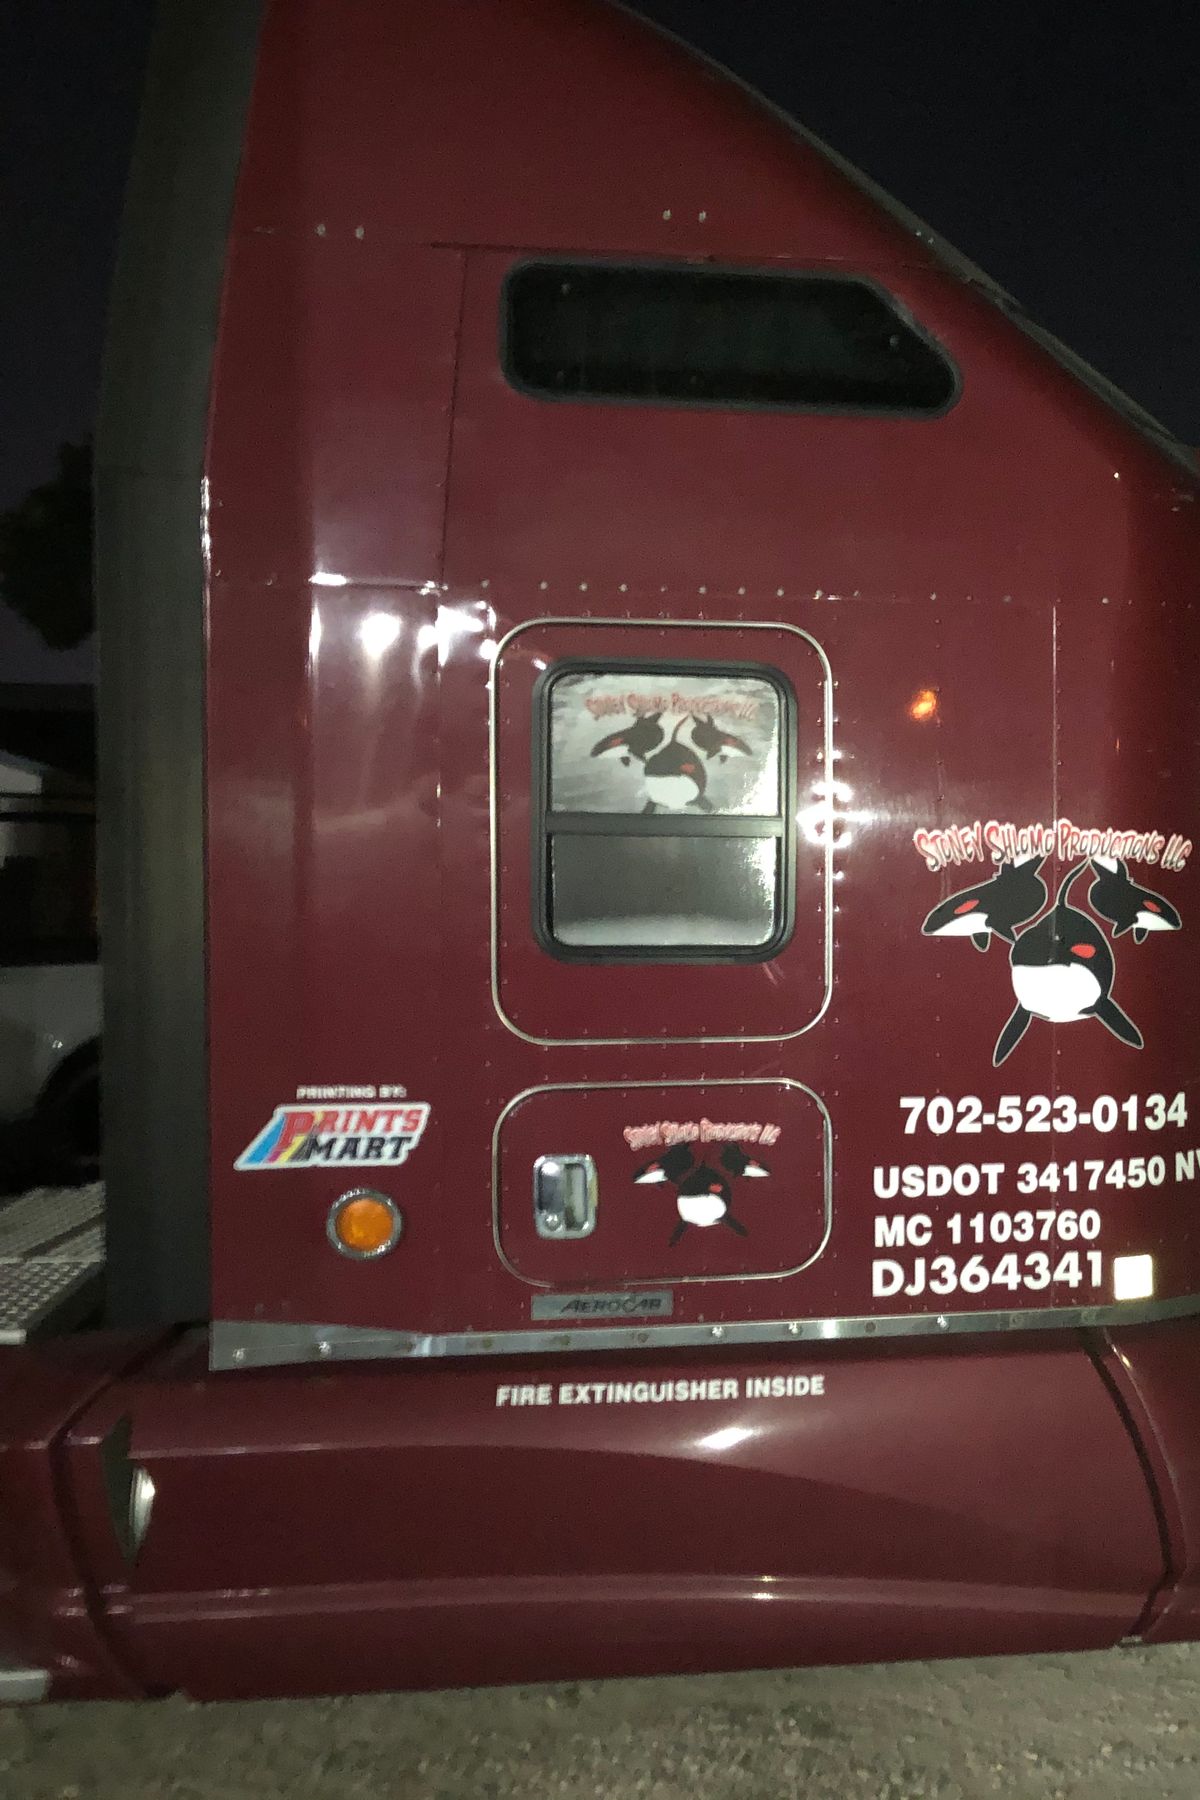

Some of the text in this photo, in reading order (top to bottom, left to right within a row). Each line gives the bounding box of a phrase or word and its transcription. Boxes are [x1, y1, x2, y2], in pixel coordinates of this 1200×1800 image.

[273, 1110, 423, 1150] PRINTS
[899, 1092, 1188, 1134] 702-523-0134
[297, 1136, 412, 1161] MART
[873, 1163, 1005, 1199] USDOT
[1016, 1155, 1166, 1194] 3417450
[873, 1209, 1101, 1248] MC 1103760
[872, 1250, 1102, 1298] DJ364341
[495, 1374, 826, 1407] FIRE EXTINGUISHER INSIDE
